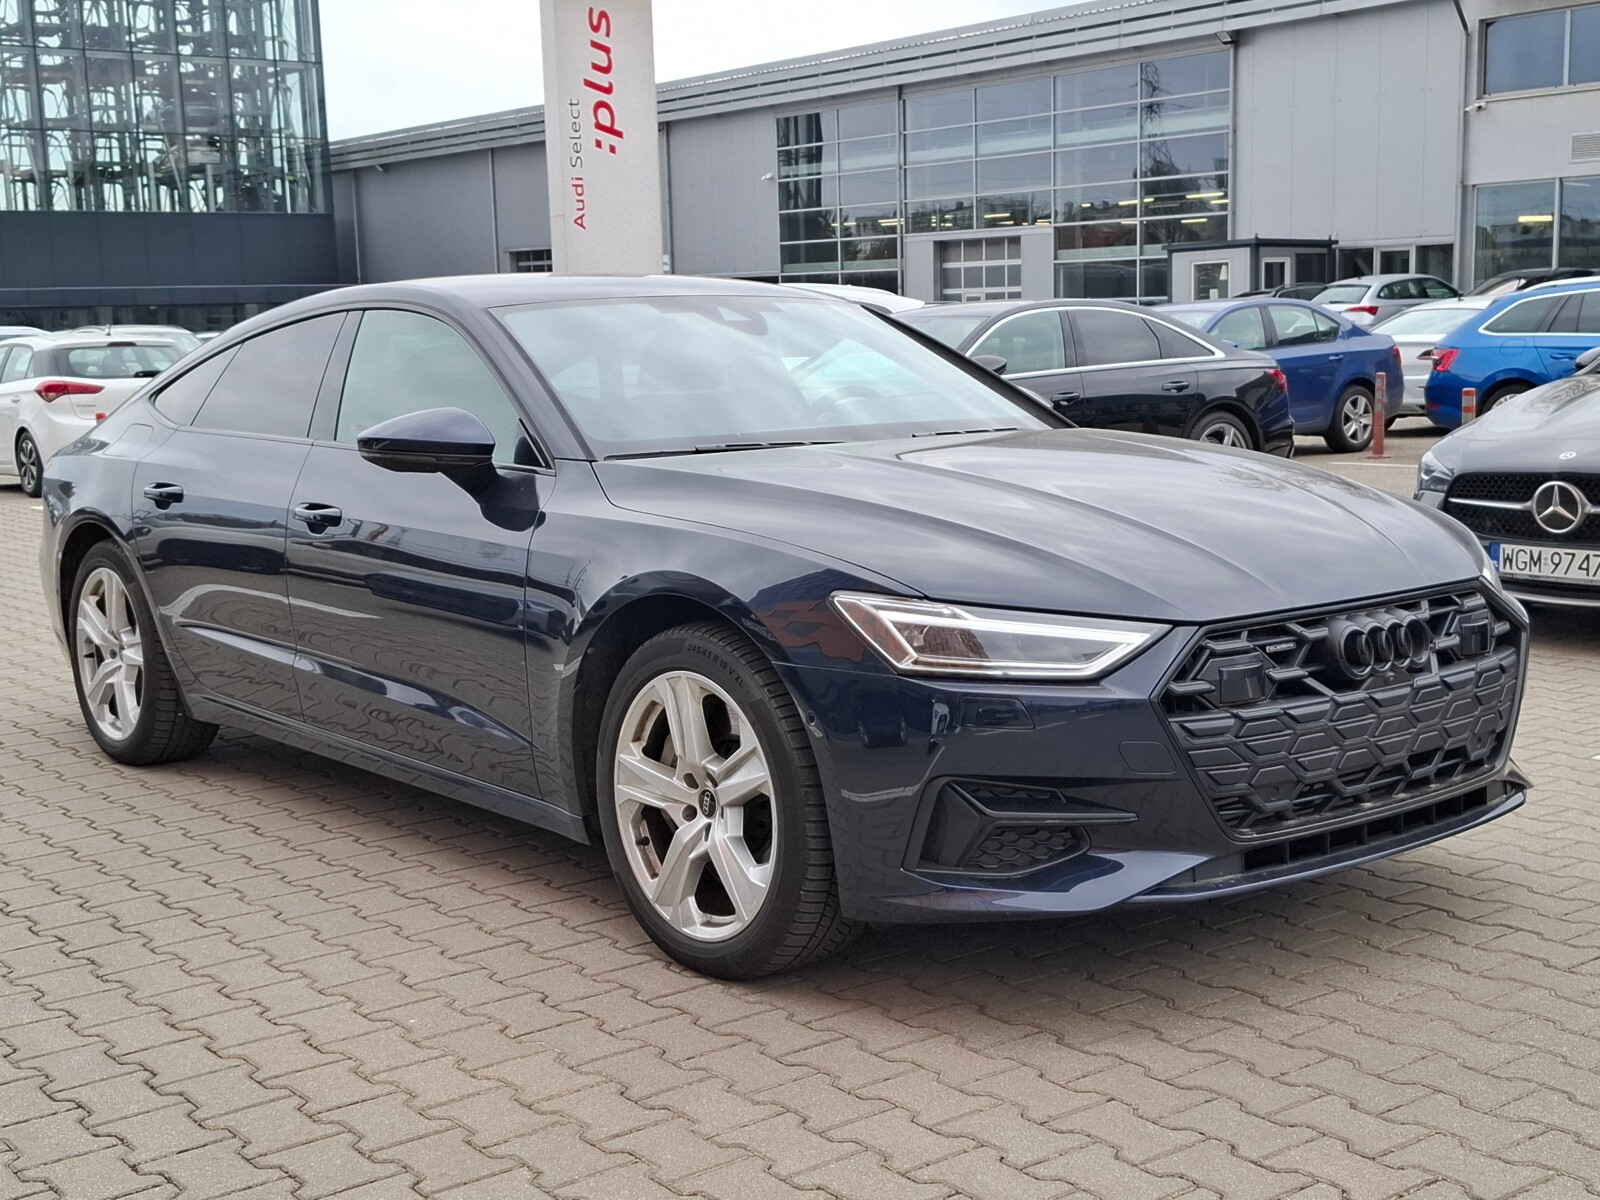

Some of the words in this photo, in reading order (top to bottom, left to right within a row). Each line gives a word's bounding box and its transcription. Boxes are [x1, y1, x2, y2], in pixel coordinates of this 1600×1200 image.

[584, 7, 624, 155] :plus
[568, 98, 583, 168] Select
[571, 177, 586, 230] Audi
[1502, 547, 1542, 573] WGM
[712, 654, 719, 663] R
